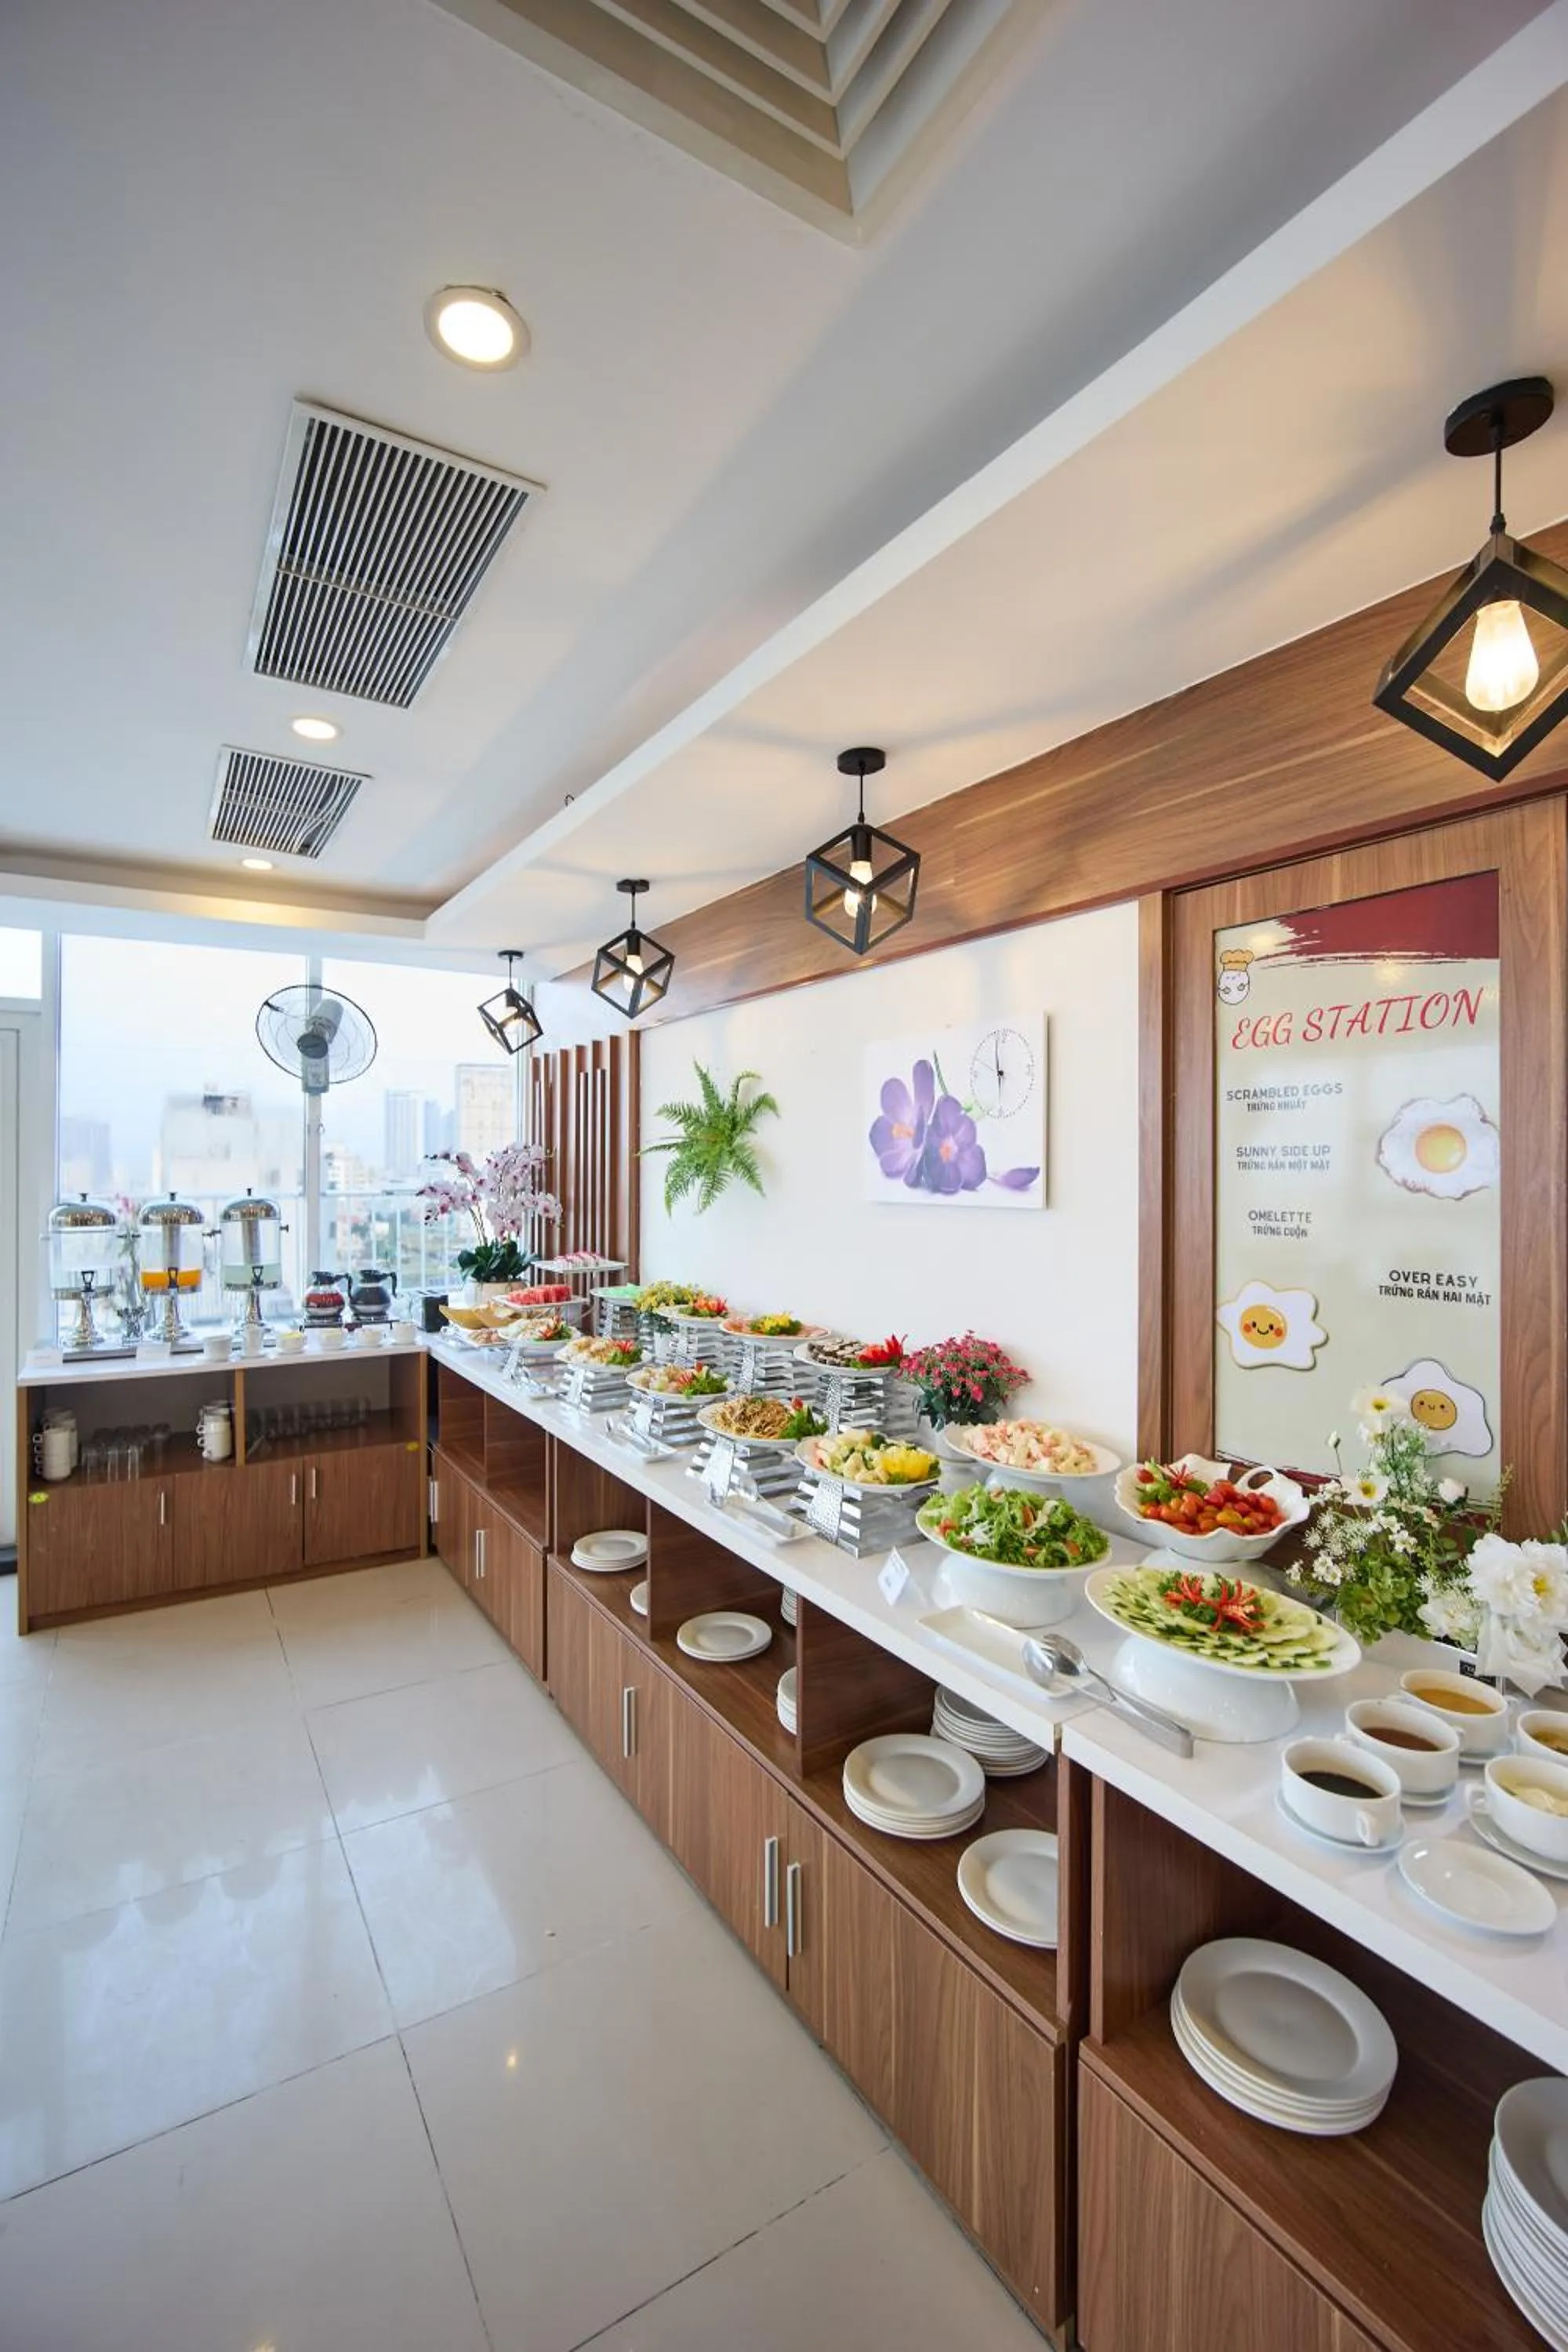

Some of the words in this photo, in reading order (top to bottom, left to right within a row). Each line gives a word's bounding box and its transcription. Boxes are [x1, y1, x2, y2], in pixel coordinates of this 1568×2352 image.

[1232, 1012, 1294, 1050] EGG
[1302, 986, 1484, 1042] STATION
[1226, 1086, 1299, 1101] SCRAMBLED
[1303, 1083, 1343, 1096] EGGS
[1236, 1145, 1277, 1158] SUNNY
[1280, 1145, 1310, 1156] SIDE
[1312, 1144, 1331, 1156] UP
[1248, 1209, 1312, 1224] OMELETTE
[1389, 1270, 1431, 1284] OVER
[1436, 1274, 1478, 1288] EASY
[1379, 1283, 1414, 1298] TRỨNG
[1443, 1290, 1462, 1302] HAI
